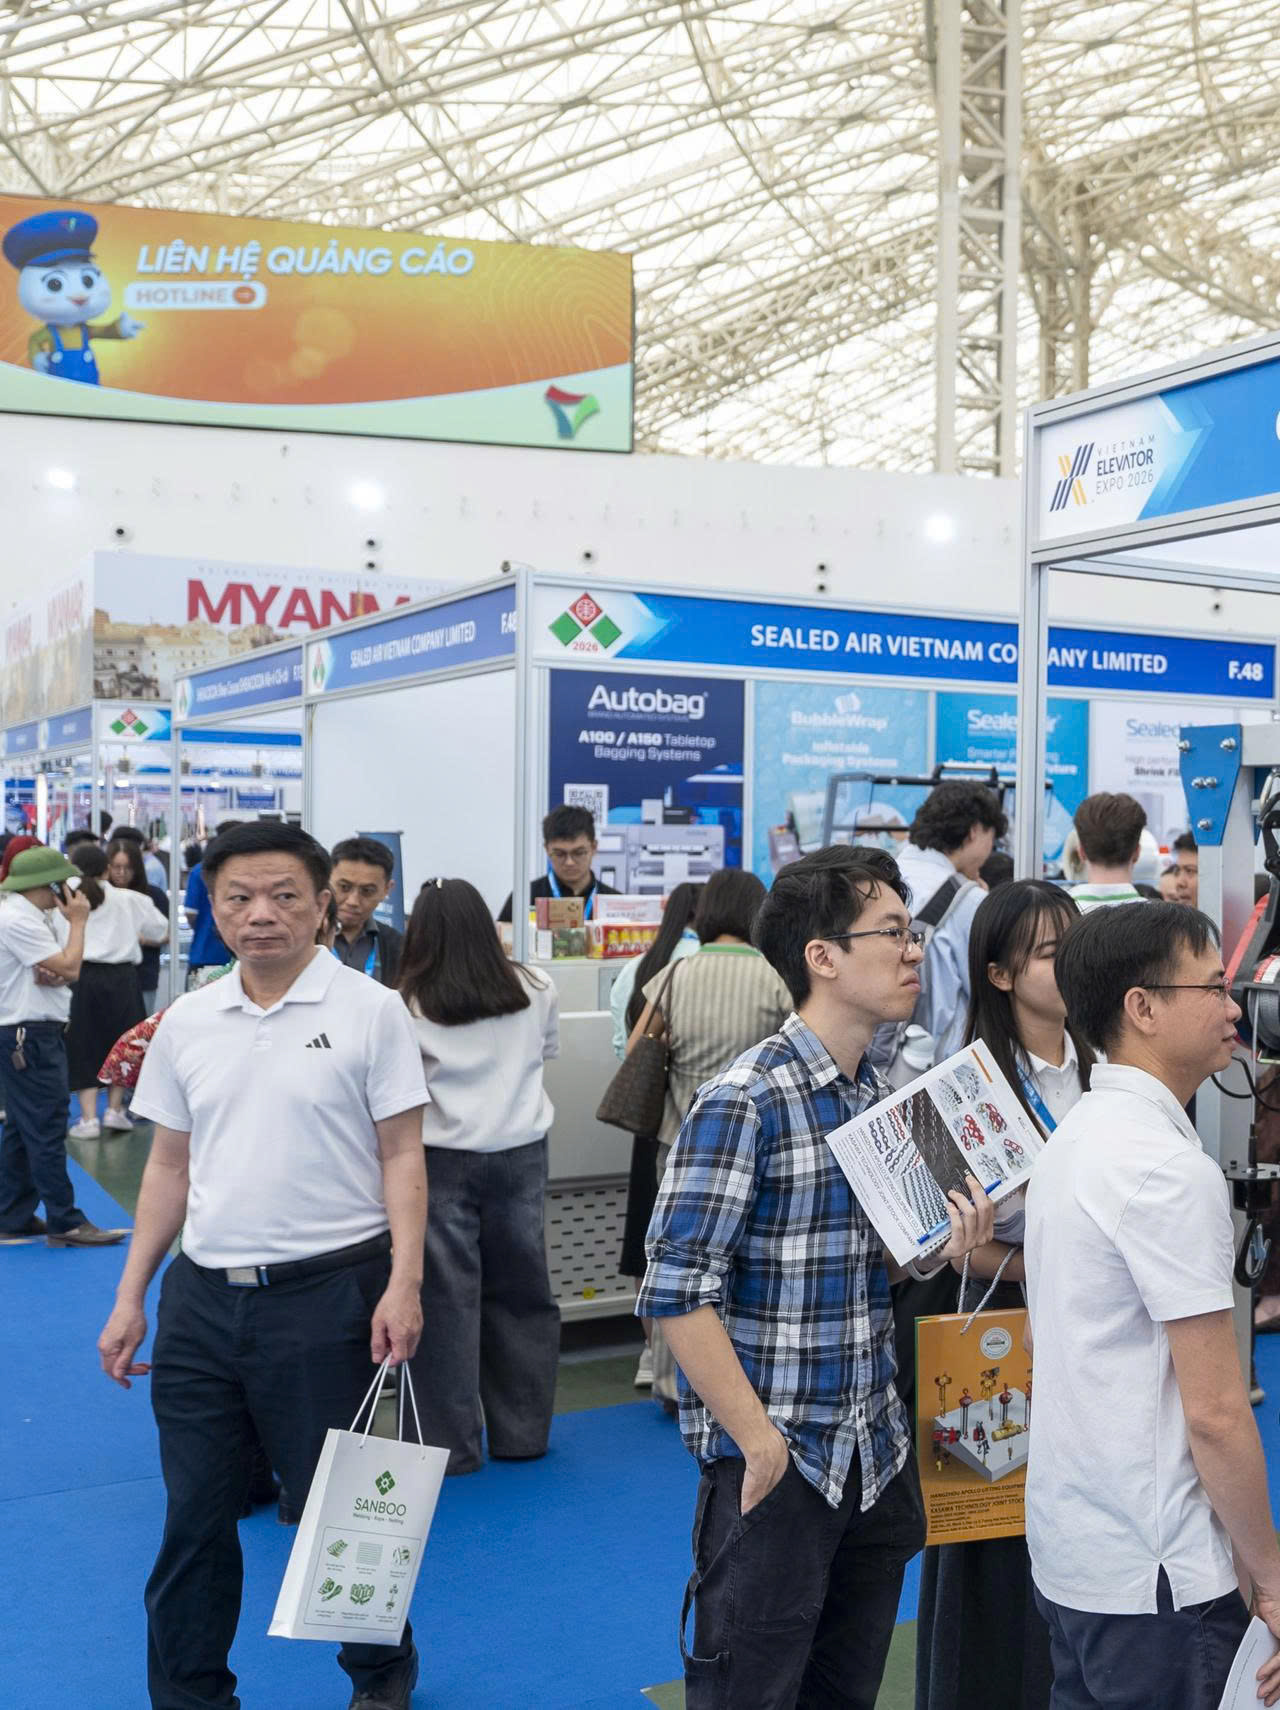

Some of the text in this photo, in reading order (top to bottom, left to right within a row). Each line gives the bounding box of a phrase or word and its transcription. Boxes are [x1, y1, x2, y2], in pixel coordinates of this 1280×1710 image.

[136, 238, 475, 282] LIÊN HỆ QUẢNG CÁO
[136, 288, 229, 304] HOTLINE
[1097, 435, 1155, 457] VIETNAM
[1096, 449, 1154, 477] ELEVATOR
[1096, 469, 1154, 495] EXPO 2026
[751, 624, 1264, 681] SEALED AIR VIETNAM COANY LIMITED F.48
[588, 684, 705, 720] Autobag
[967, 709, 1018, 731] Seale
[578, 730, 616, 744] A100
[664, 733, 716, 749] Tabletop
[594, 745, 702, 762] Bagging Systems
[354, 1497, 407, 1516] SANBOO
